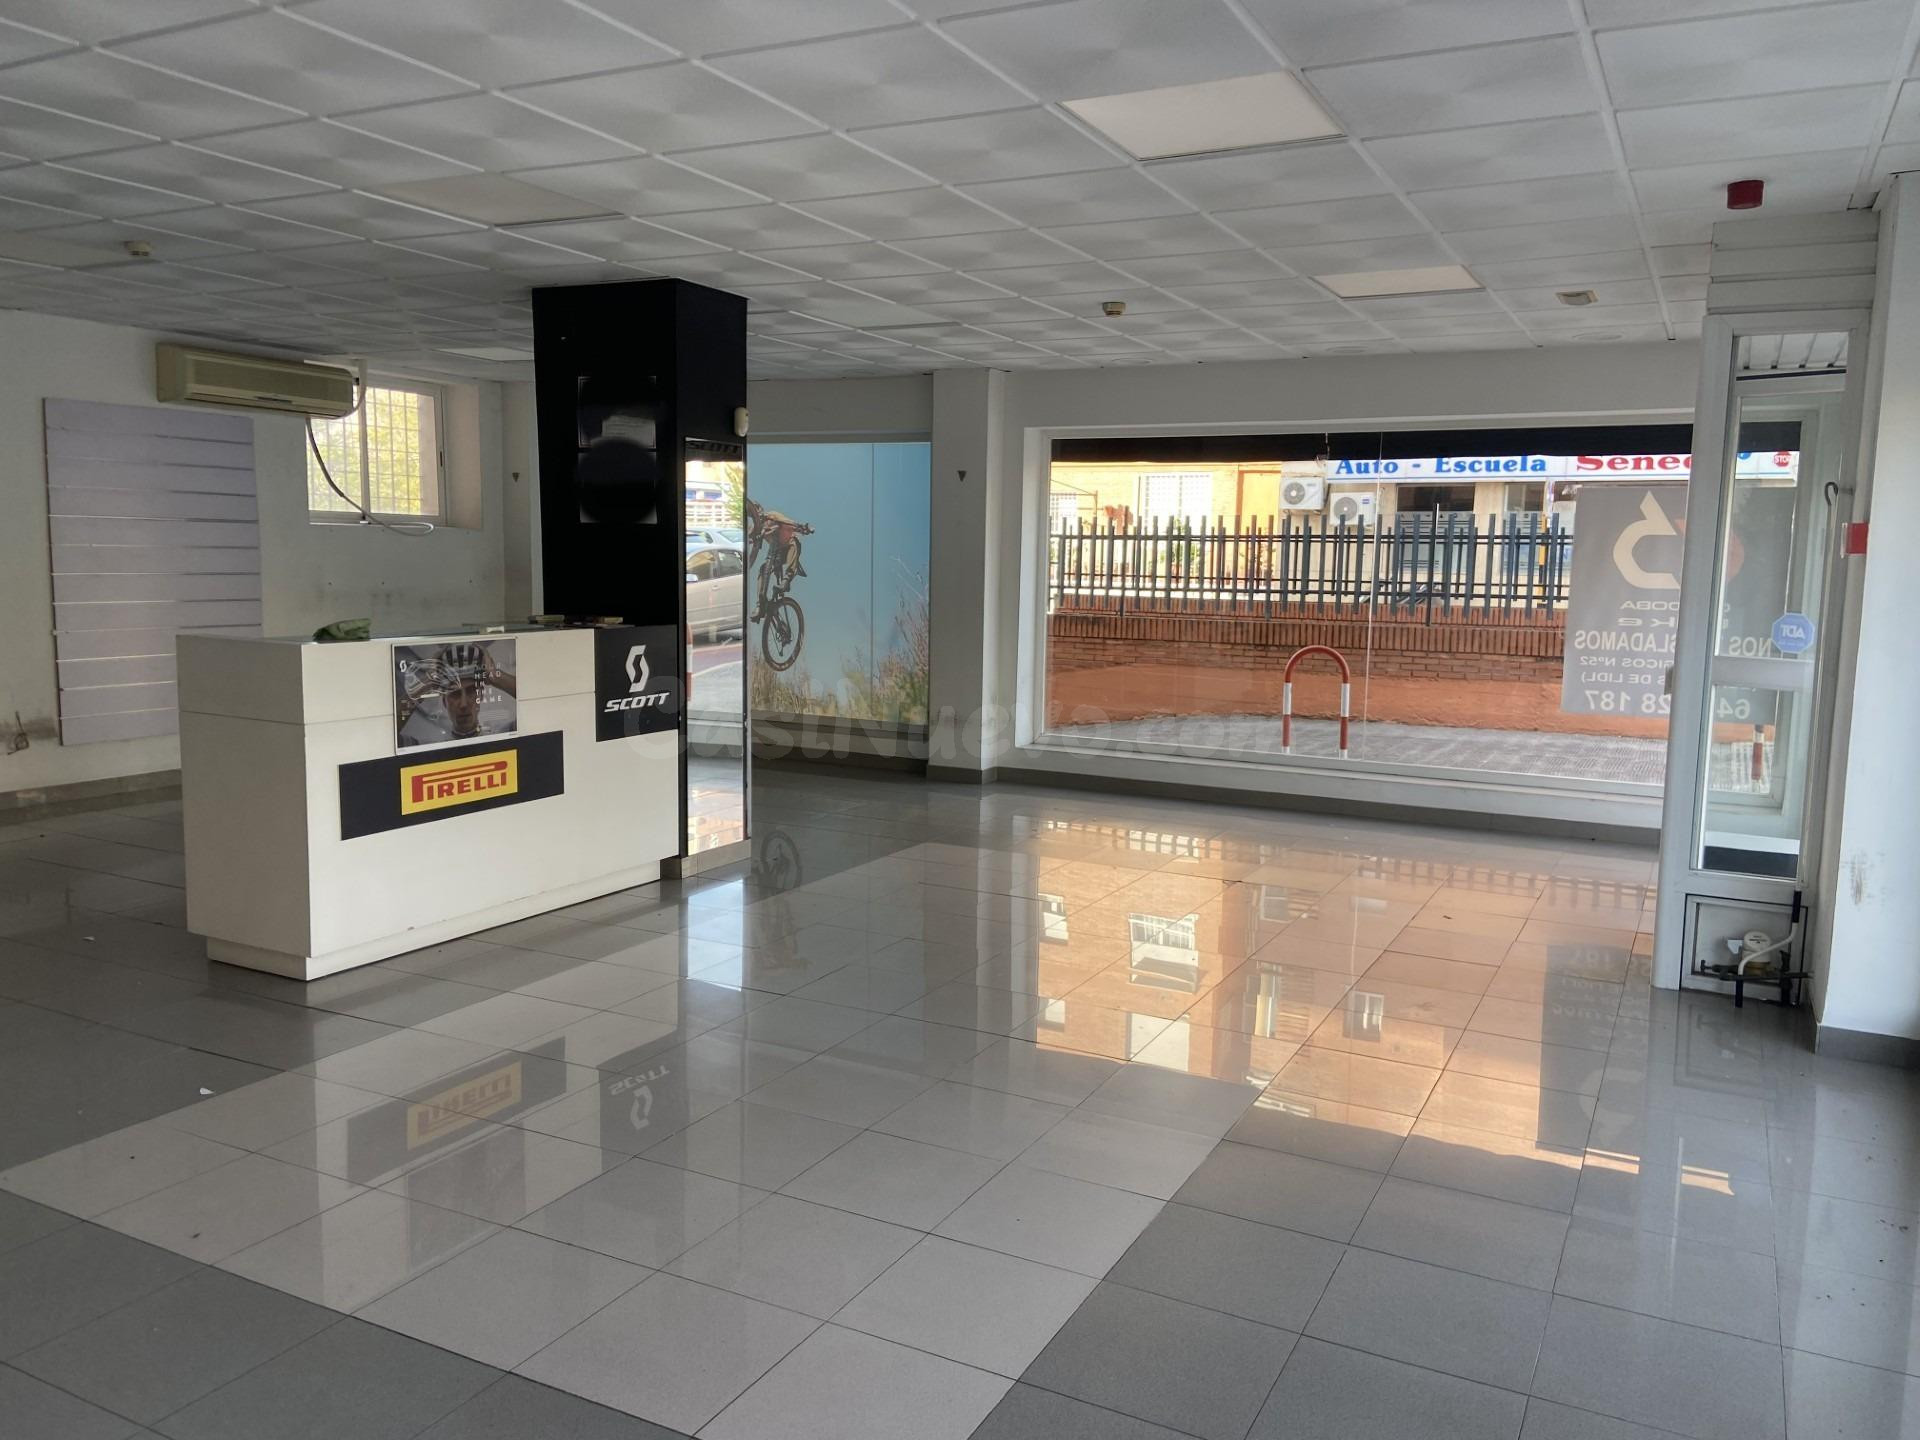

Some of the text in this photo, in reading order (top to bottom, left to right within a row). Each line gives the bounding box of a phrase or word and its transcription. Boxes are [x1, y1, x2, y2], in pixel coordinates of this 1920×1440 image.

[1336, 459, 1398, 475] Auto
[1435, 456, 1547, 473] Escuela
[475, 695, 503, 705] GAME
[603, 692, 671, 713] SCOTT
[411, 759, 509, 803] PIRELLI
